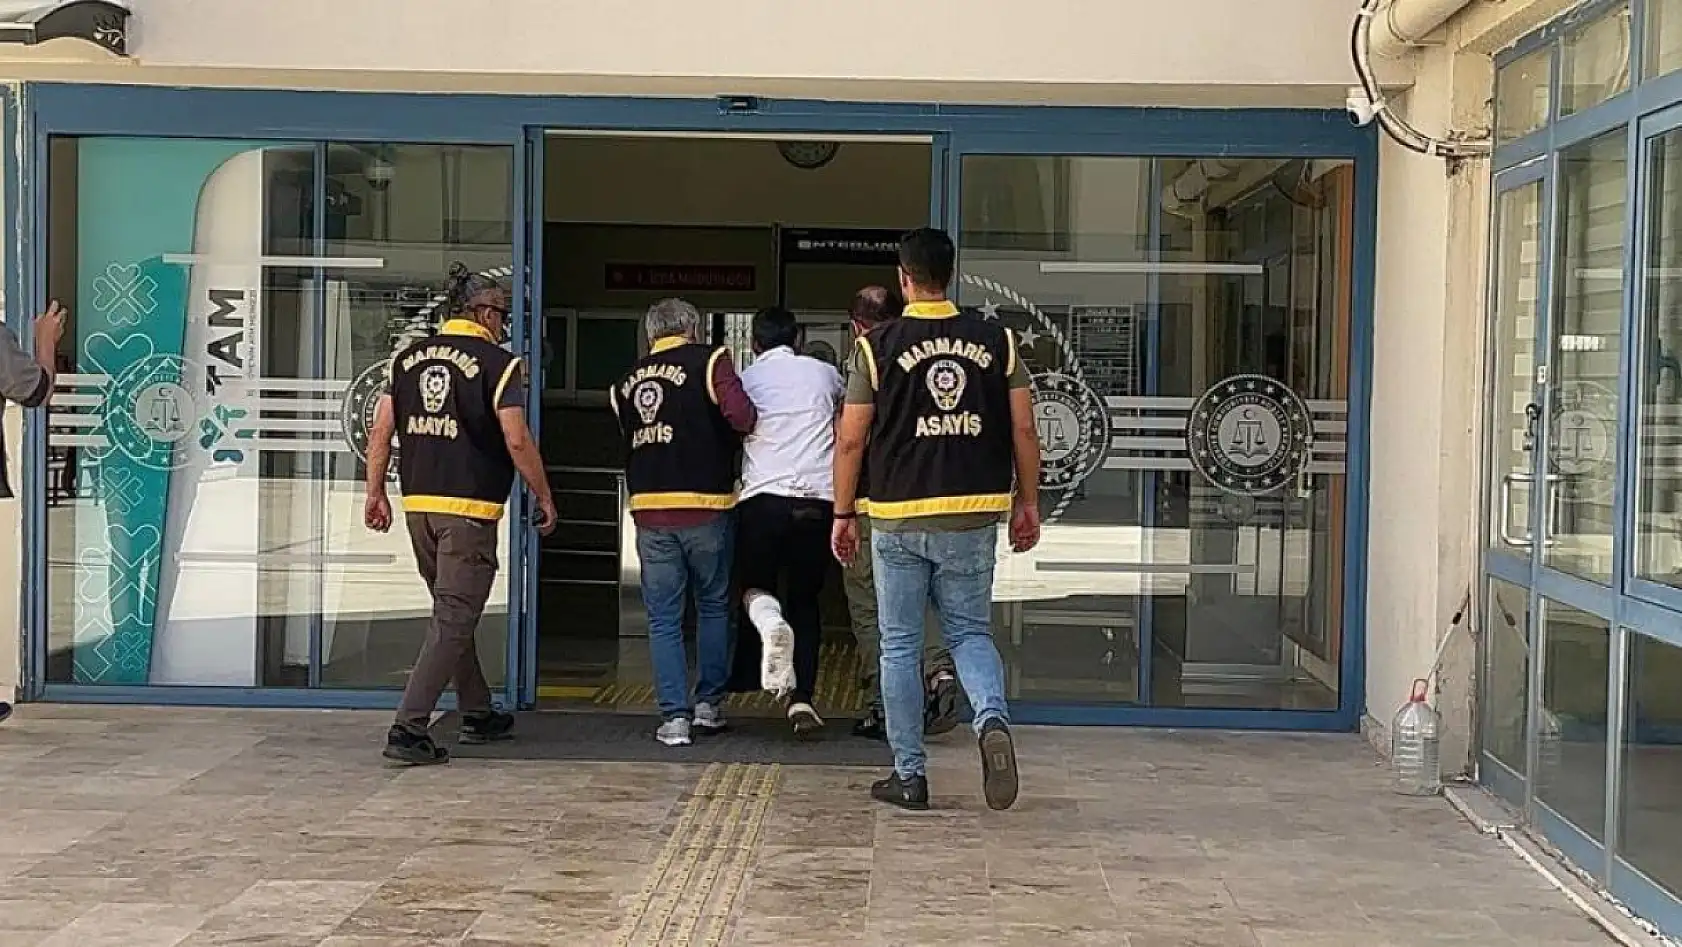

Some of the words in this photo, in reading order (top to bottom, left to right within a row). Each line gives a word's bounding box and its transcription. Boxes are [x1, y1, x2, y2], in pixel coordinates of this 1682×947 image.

[402, 345, 480, 378] MARMARİS
[896, 336, 993, 374] MARMARİS
[621, 363, 687, 400] MARMARİS
[915, 410, 982, 437] ASAYİŞ
